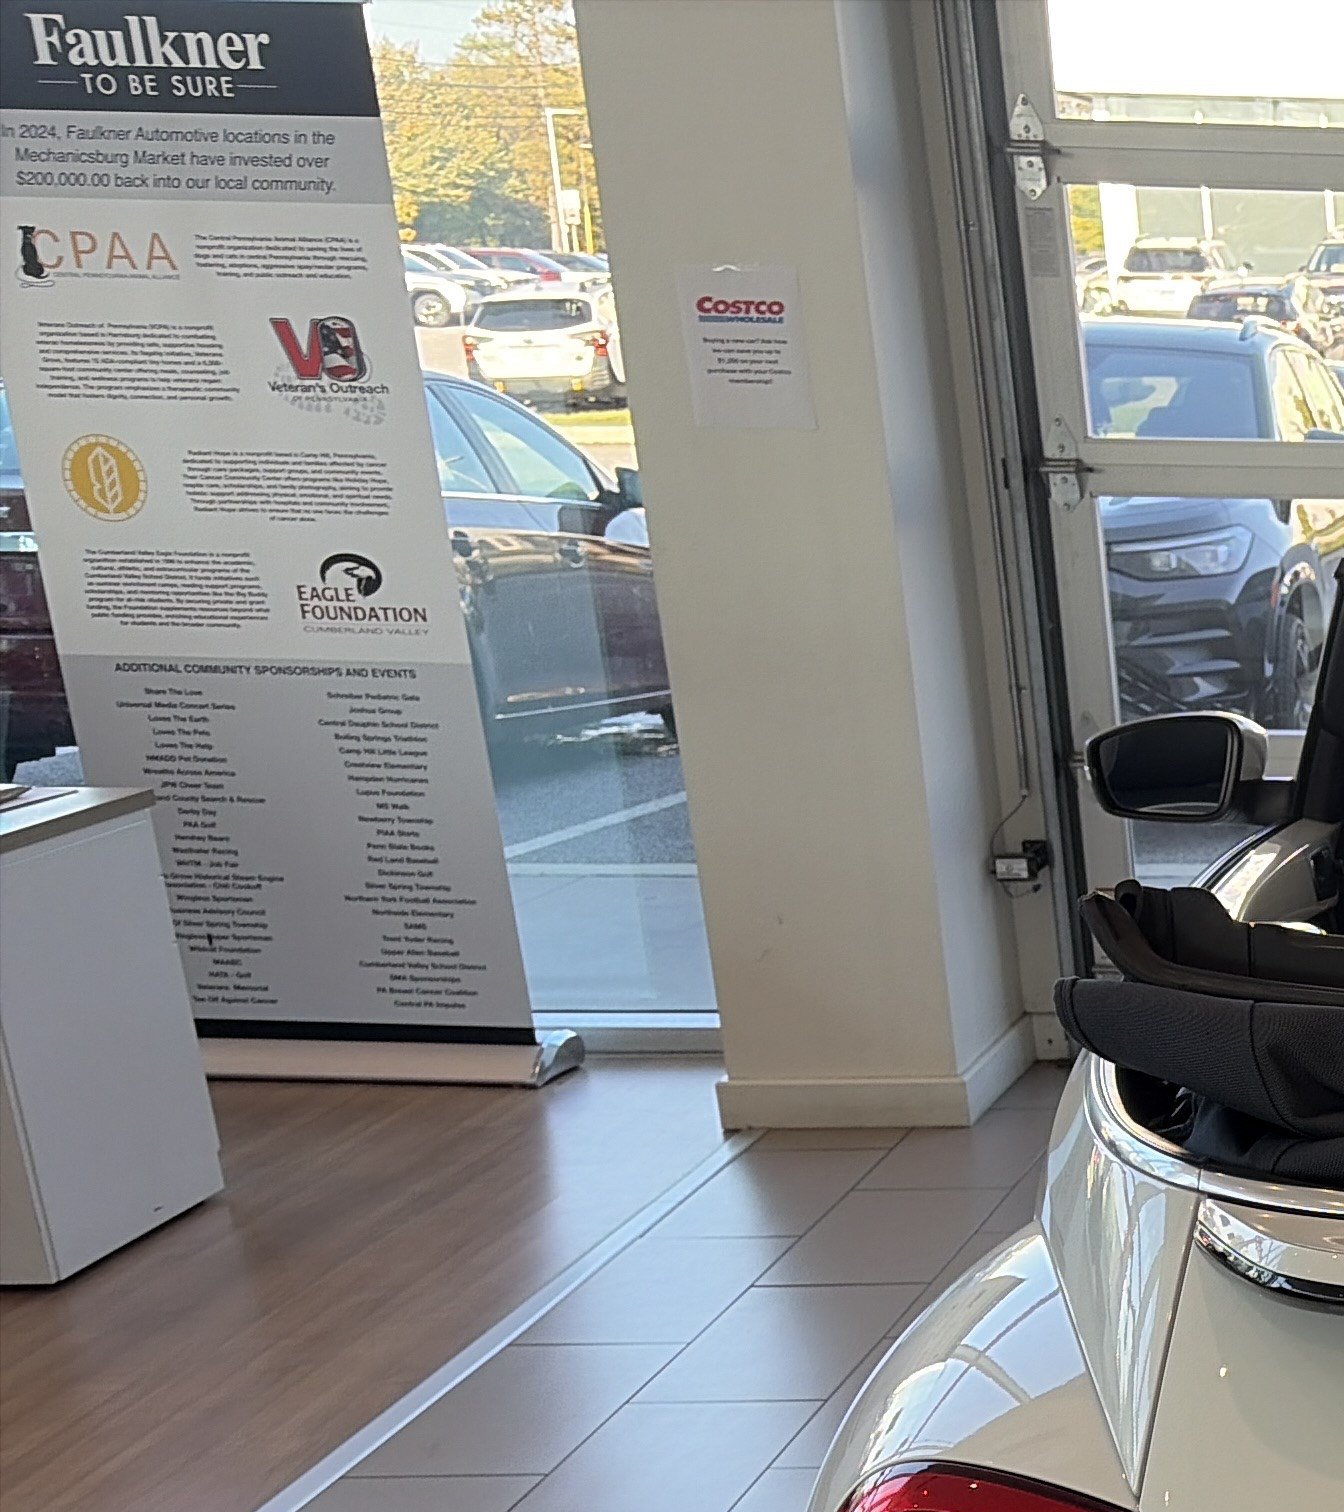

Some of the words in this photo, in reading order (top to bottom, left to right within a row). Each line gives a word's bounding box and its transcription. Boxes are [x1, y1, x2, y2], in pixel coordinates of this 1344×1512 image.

[24, 13, 270, 70] Faulkner
[80, 73, 117, 95] TO
[129, 74, 159, 96] BE
[171, 75, 235, 97] SURE
[1, 124, 15, 137] In
[19, 124, 61, 140] 2024,
[67, 125, 132, 140] Faulkner
[134, 127, 219, 142] Automotive
[223, 129, 290, 144] locations
[294, 130, 307, 144] in
[312, 131, 336, 145] the
[15, 147, 129, 168] Mechanicsburg
[133, 150, 186, 165] Market
[190, 152, 225, 166] have
[229, 152, 293, 168] invested
[296, 156, 330, 168] over
[114, 174, 148, 188] back
[153, 174, 181, 189] into
[186, 178, 211, 189] our
[214, 175, 248, 190] local
[251, 177, 336, 195] community.
[32, 229, 178, 271] CPAA
[696, 296, 785, 316] COSTCO
[267, 381, 327, 394] Veteran's
[329, 382, 390, 395] Outreach
[296, 584, 356, 603] EAGLE
[300, 603, 428, 623] FOUNDATION
[303, 625, 383, 635] CUMBERLAND
[386, 628, 429, 636] VALLEY
[115, 663, 182, 673] ADDITIONAL
[184, 664, 251, 675] COMMUNITY
[254, 665, 342, 677] SPONSORSHIPS
[345, 668, 368, 678] AND
[371, 668, 416, 679] EVENTS
